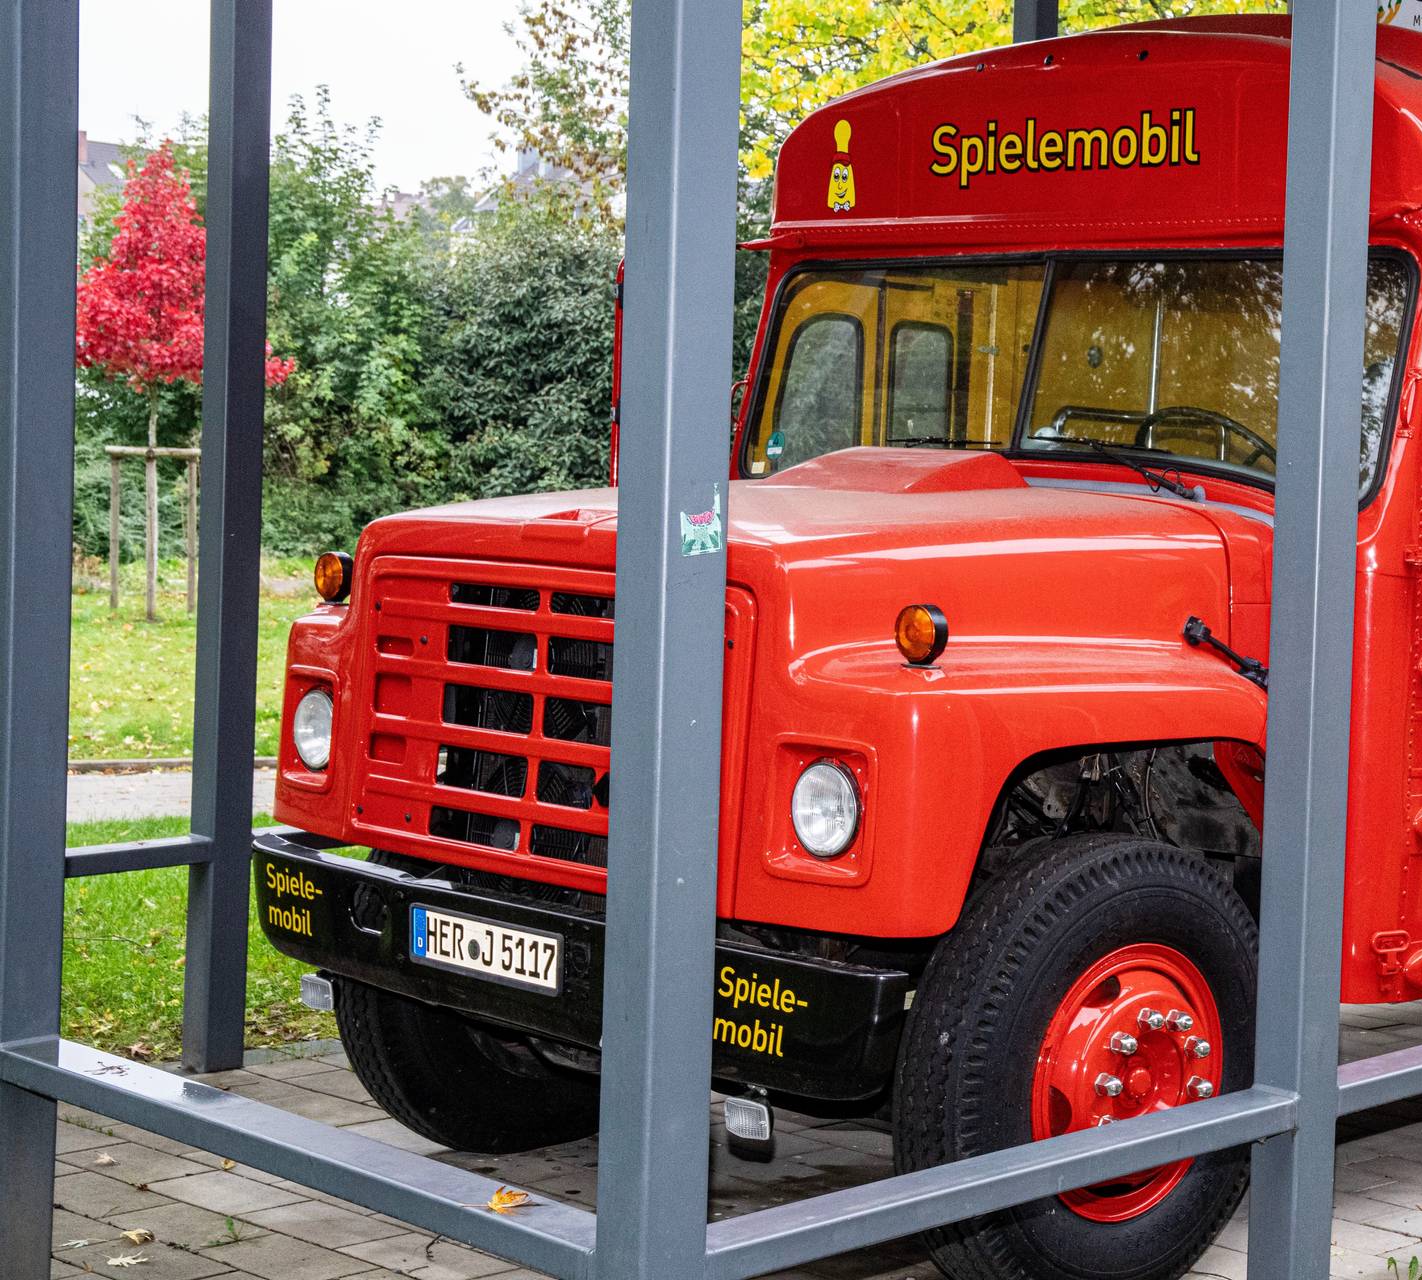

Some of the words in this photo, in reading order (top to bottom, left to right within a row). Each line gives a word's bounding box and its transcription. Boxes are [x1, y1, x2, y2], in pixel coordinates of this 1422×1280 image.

[929, 108, 1200, 189] Spielemobil
[266, 863, 323, 900] Spiele-
[268, 905, 313, 937] mobil
[426, 916, 464, 961] HER
[481, 930, 494, 967] J
[501, 933, 556, 980] 5117
[718, 966, 809, 1013] Spiele-
[713, 1017, 784, 1058] mobil
